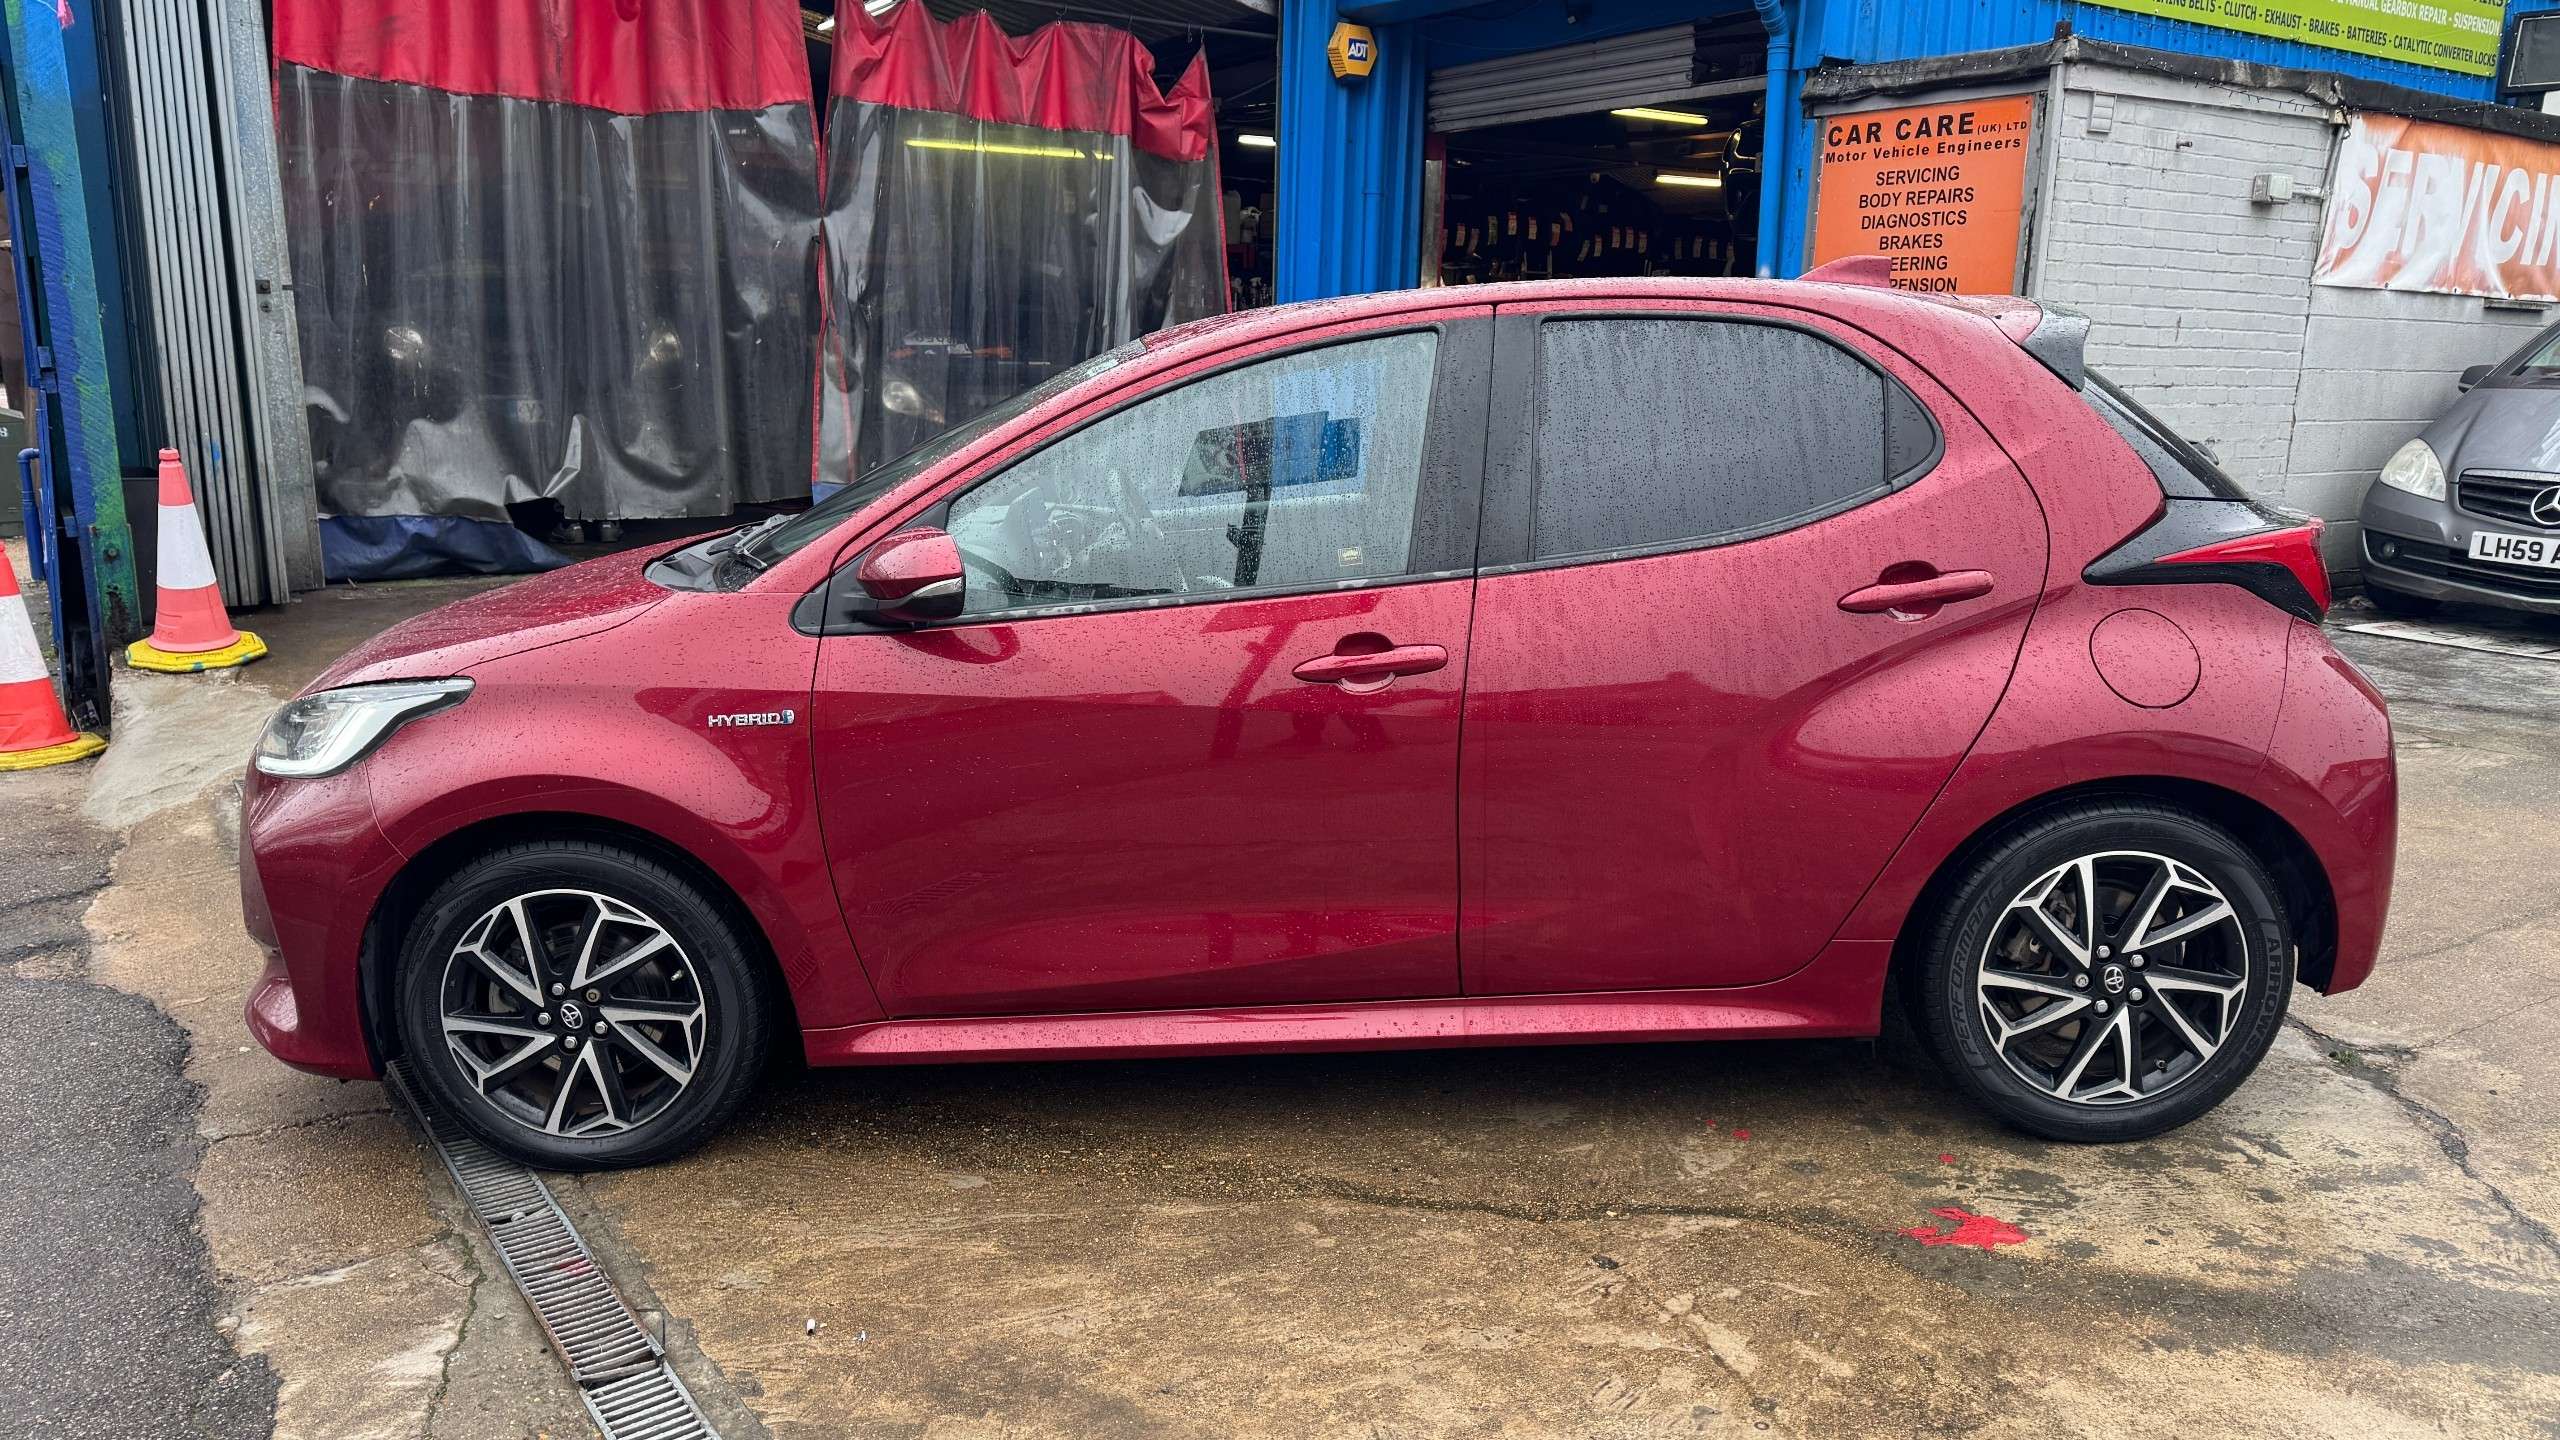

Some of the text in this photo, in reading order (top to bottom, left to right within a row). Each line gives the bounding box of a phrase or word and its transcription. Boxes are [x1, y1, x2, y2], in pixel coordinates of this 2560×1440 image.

[2381, 0, 2418, 19] GEARBOX
[2420, 5, 2448, 25] REPAIR
[2453, 12, 2501, 36] SUSPENSION
[2188, 0, 2216, 13] BELTS
[2224, 0, 2257, 21] CLUTCH
[2264, 8, 2302, 30] EXHAUST
[2308, 17, 2340, 37] BRAKES
[2346, 25, 2387, 47] BATTERIES
[2393, 35, 2432, 56] CATALYTIC
[2433, 42, 2474, 63] CONVERTER
[2474, 51, 2497, 67] LOCKS
[1348, 40, 1368, 58] ADT
[1828, 112, 2027, 147] CAR CARE (UK) LTD
[1825, 137, 2021, 163] Motor Vehicle Engineers
[1875, 165, 1960, 186] SERVICING
[1858, 187, 1975, 209] BODY REPAIRS
[1861, 210, 1967, 230] DIAGNOSTICS
[1879, 233, 1943, 250] BRAKES
[1890, 256, 1948, 271] EERING
[1890, 277, 1958, 292] PENSION
[2480, 535, 2544, 562] LH59
[708, 712, 781, 728] HYBRID
